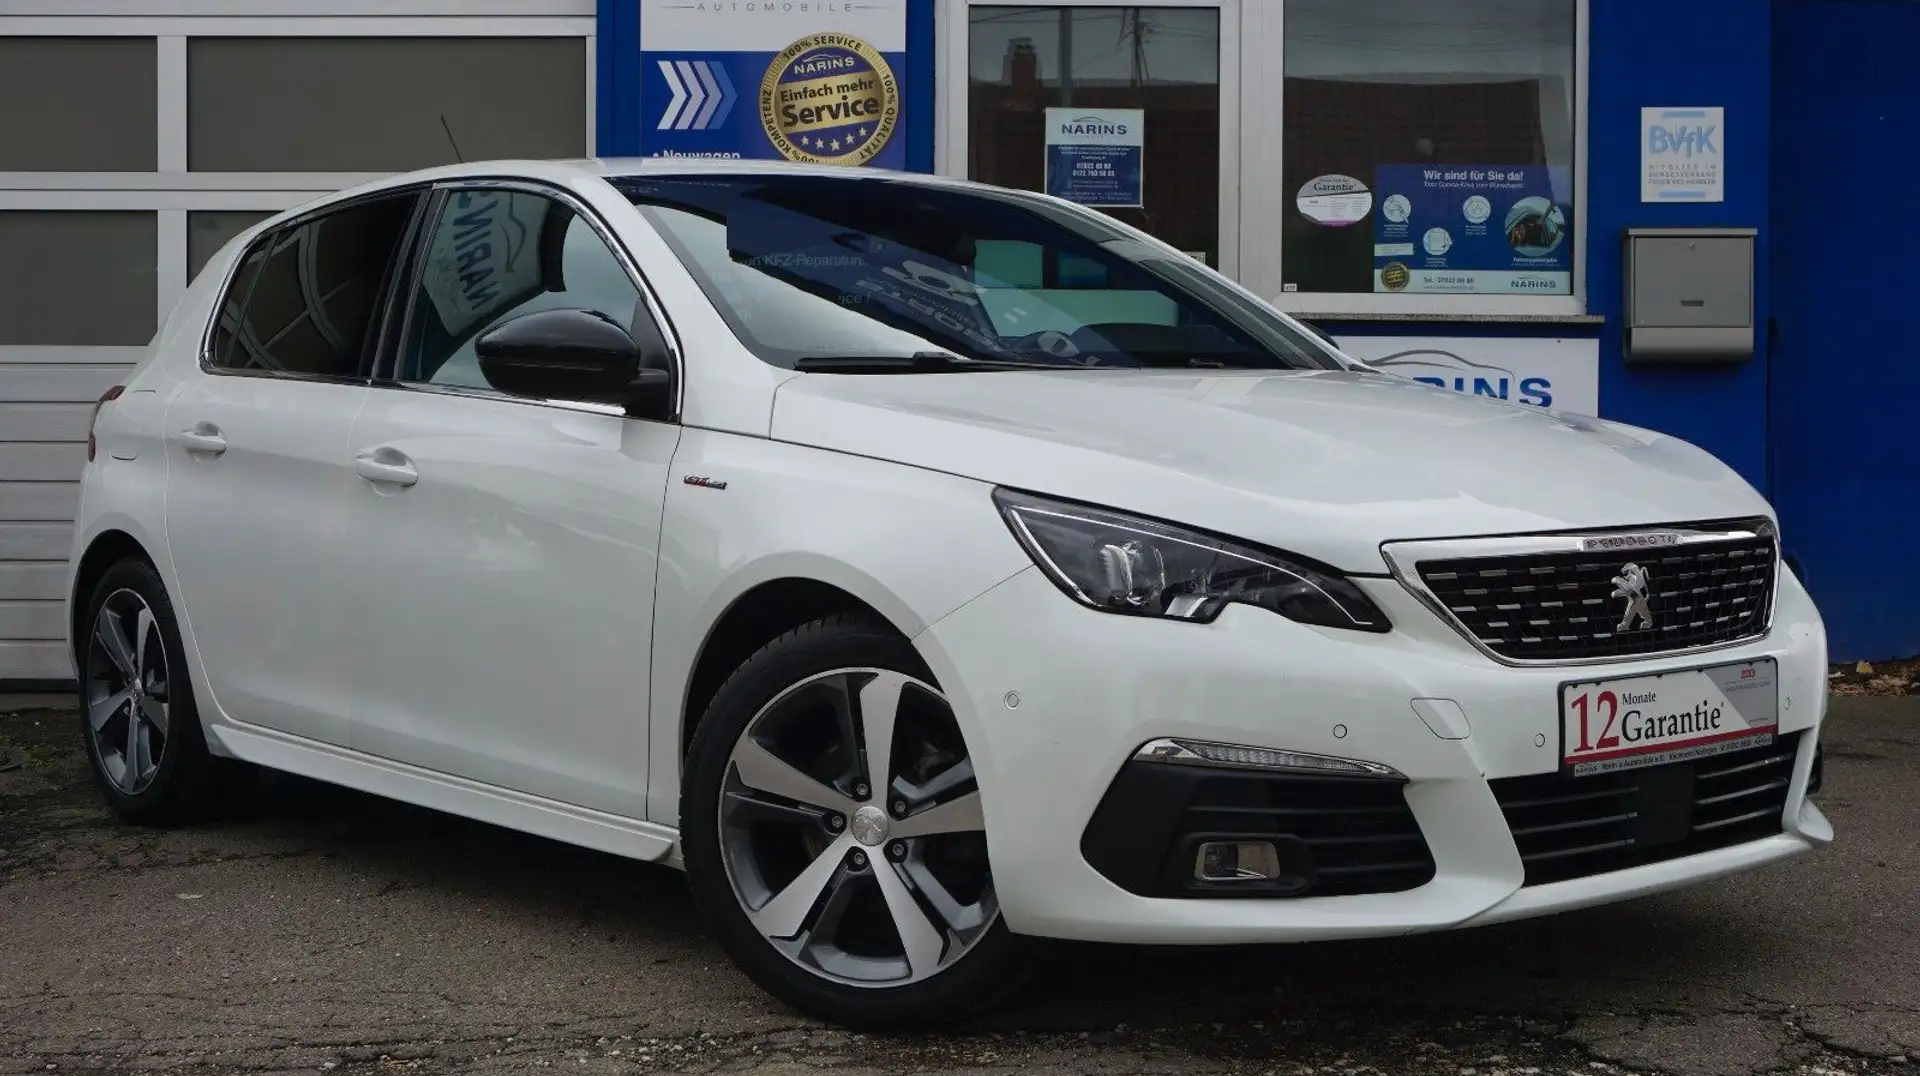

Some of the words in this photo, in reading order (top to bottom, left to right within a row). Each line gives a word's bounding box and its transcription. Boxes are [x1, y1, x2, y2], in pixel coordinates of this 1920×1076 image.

[697, 2, 852, 12] AUTOMOBILE
[783, 39, 813, 60] 100%
[813, 36, 863, 52] SERVICE
[780, 83, 833, 102] Einfach
[836, 78, 875, 94] mehr
[882, 73, 896, 105] 100%
[761, 89, 791, 154] KOMPETENZ
[781, 94, 880, 127] Service
[859, 106, 896, 160] QUALITÄT
[1061, 124, 1128, 135] NARINS
[1648, 124, 1718, 159] BVfK
[1313, 182, 1354, 191] Garantie
[1424, 170, 1442, 180] Wir
[1444, 170, 1468, 180] sind
[1469, 170, 1486, 180] für
[1487, 171, 1506, 180] Sie
[1507, 171, 1524, 180] da!
[1510, 280, 1557, 288] NARINS
[1570, 690, 1620, 753] 12
[1621, 691, 1657, 706] Monate
[1621, 699, 1722, 742] Garantie
